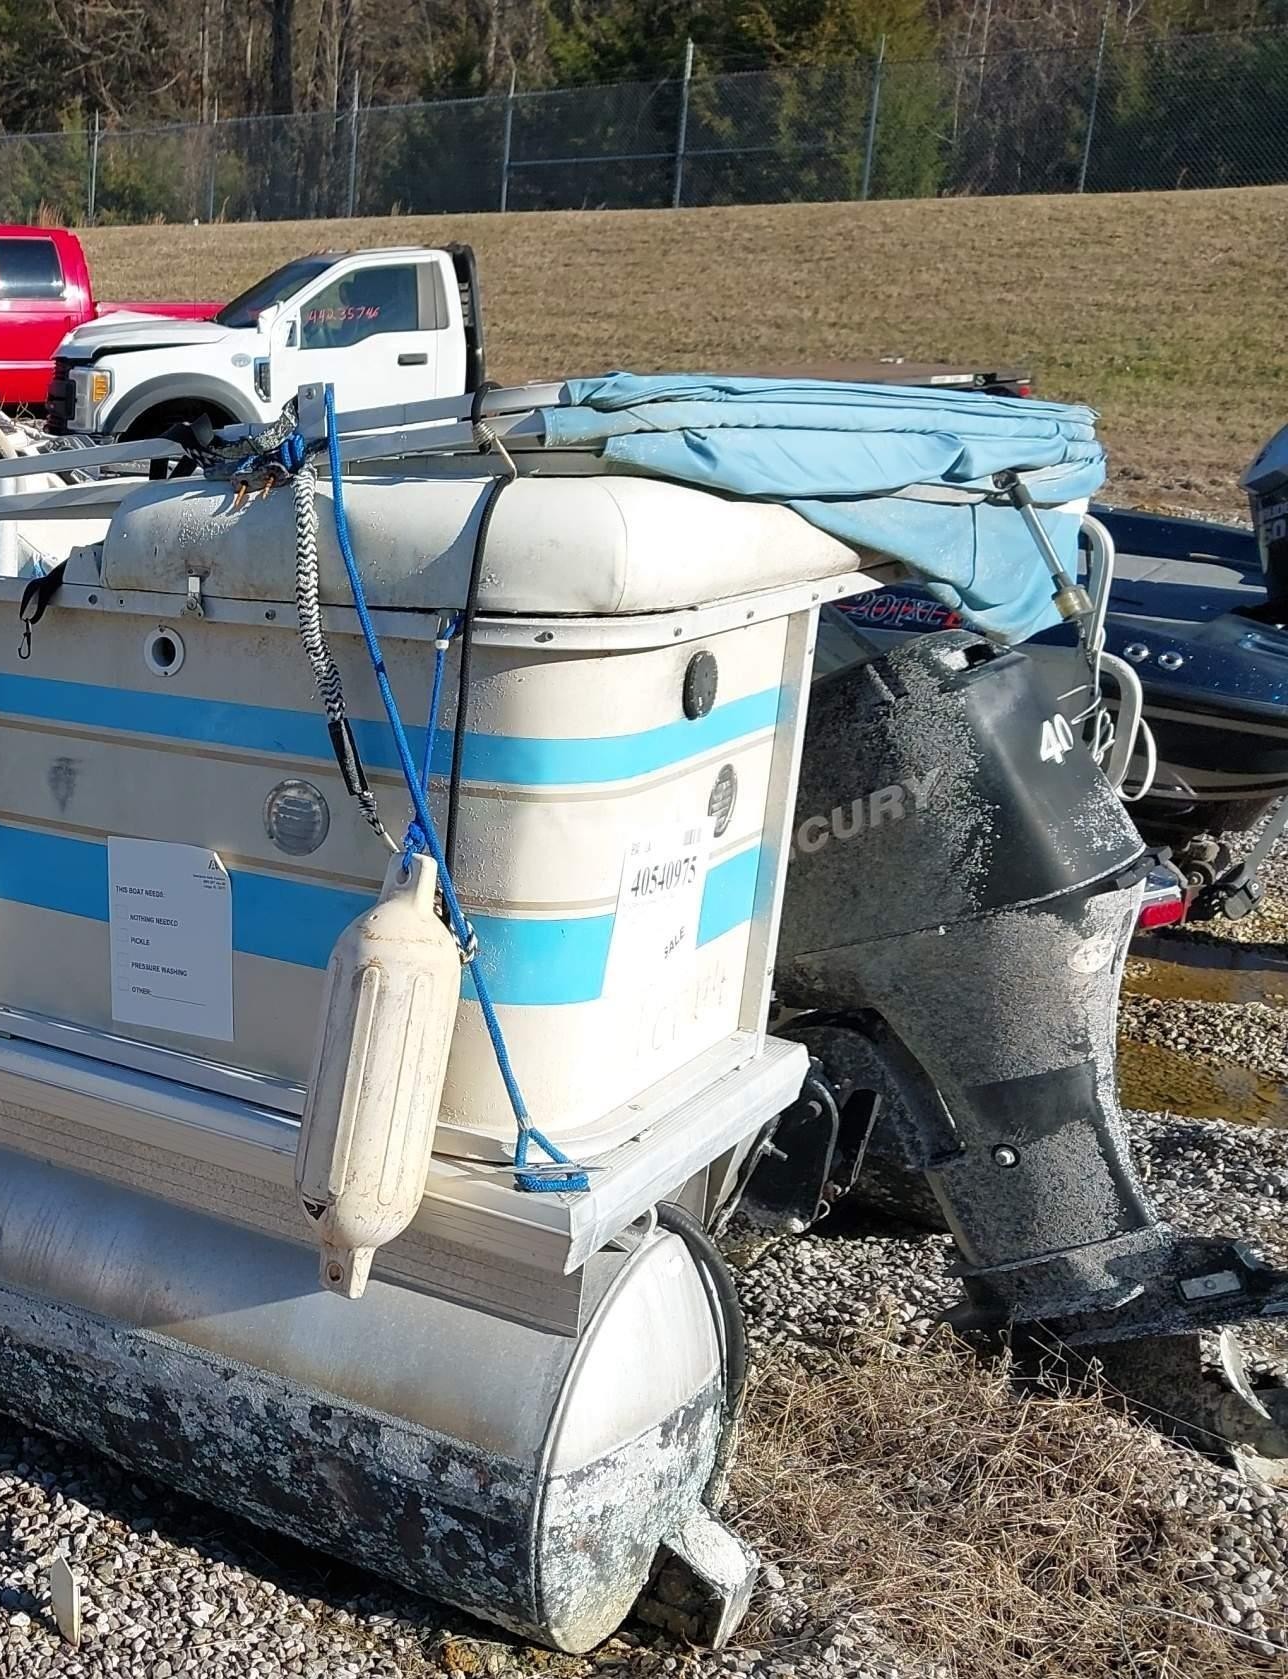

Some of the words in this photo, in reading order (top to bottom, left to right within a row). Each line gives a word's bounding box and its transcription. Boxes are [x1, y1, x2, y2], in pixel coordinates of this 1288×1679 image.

[1039, 713, 1073, 765] 40
[789, 766, 946, 862] CURY
[630, 855, 698, 897] 40540975
[115, 885, 128, 894] THIS
[128, 887, 144, 896] BOAT
[130, 914, 154, 924] NOTHING
[155, 917, 178, 927] NEEDED
[130, 936, 150, 946] PICKLE
[131, 961, 160, 973] PRESSURE
[161, 966, 188, 977] WASHING
